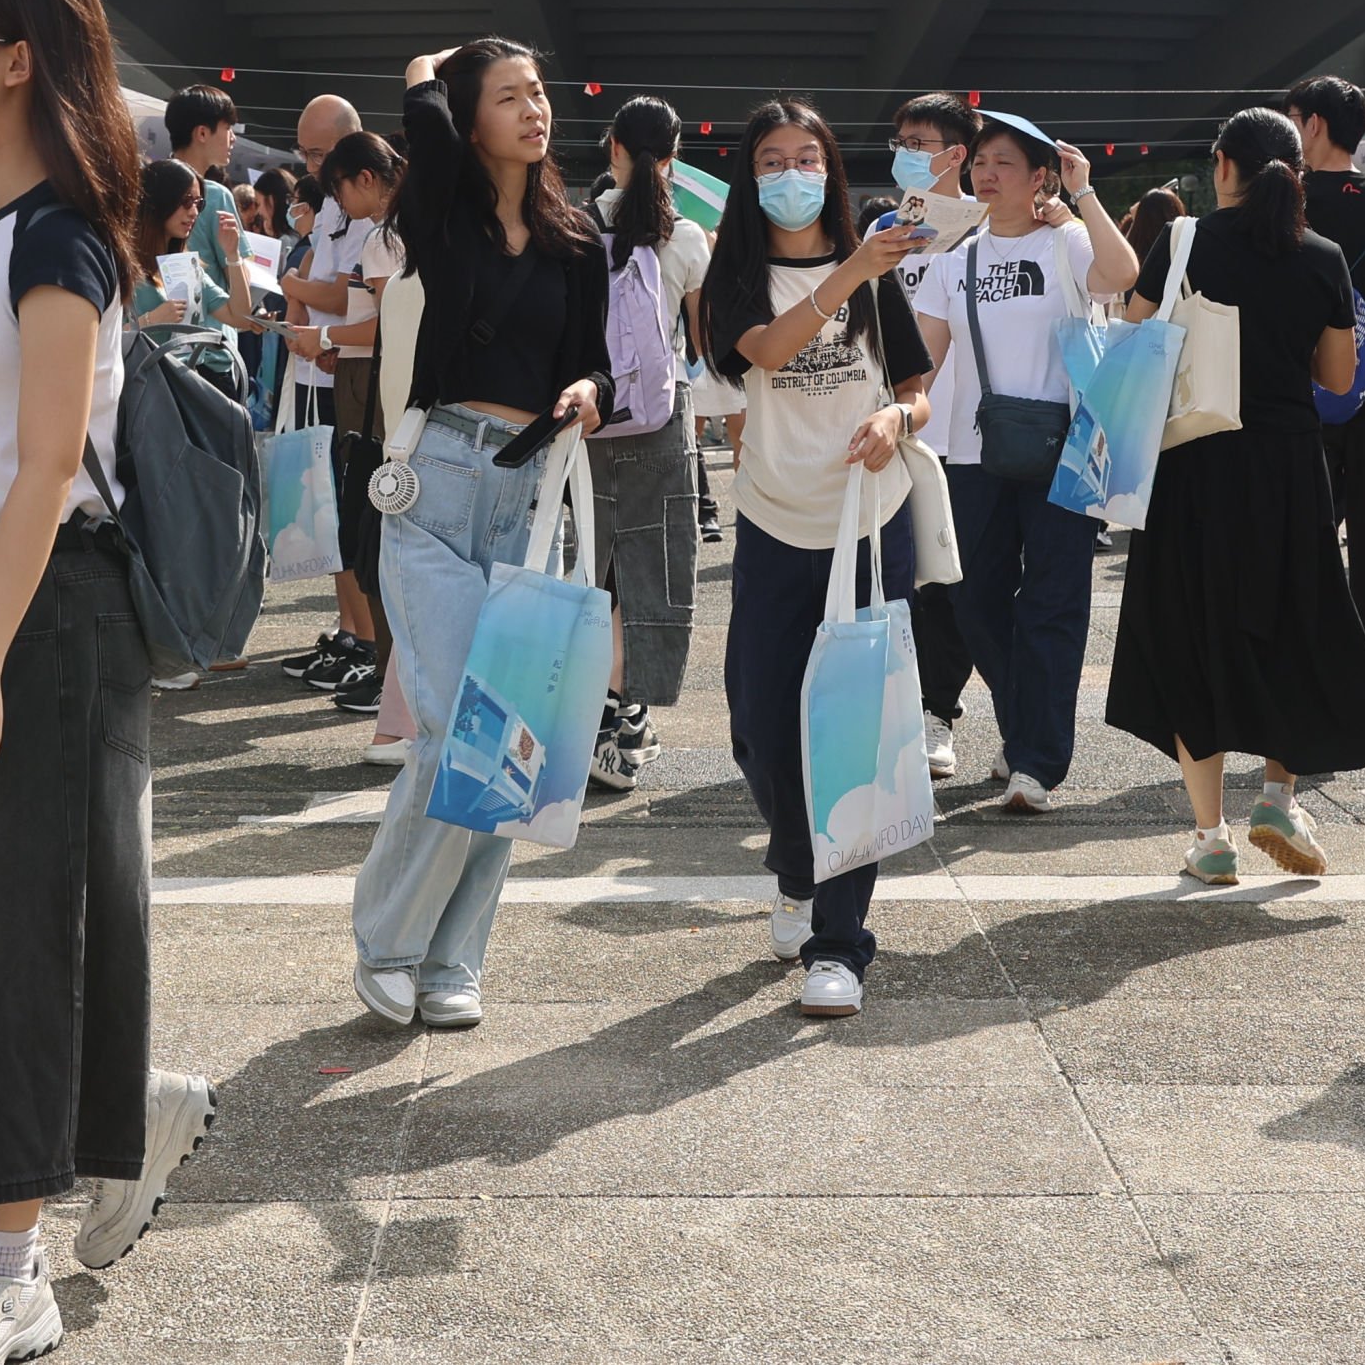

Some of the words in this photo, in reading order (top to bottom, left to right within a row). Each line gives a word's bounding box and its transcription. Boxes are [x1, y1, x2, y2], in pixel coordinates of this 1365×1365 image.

[988, 261, 1018, 276] THE
[814, 373, 824, 386] OF
[826, 369, 867, 385] COLUMBIA
[901, 810, 931, 841] DAY
